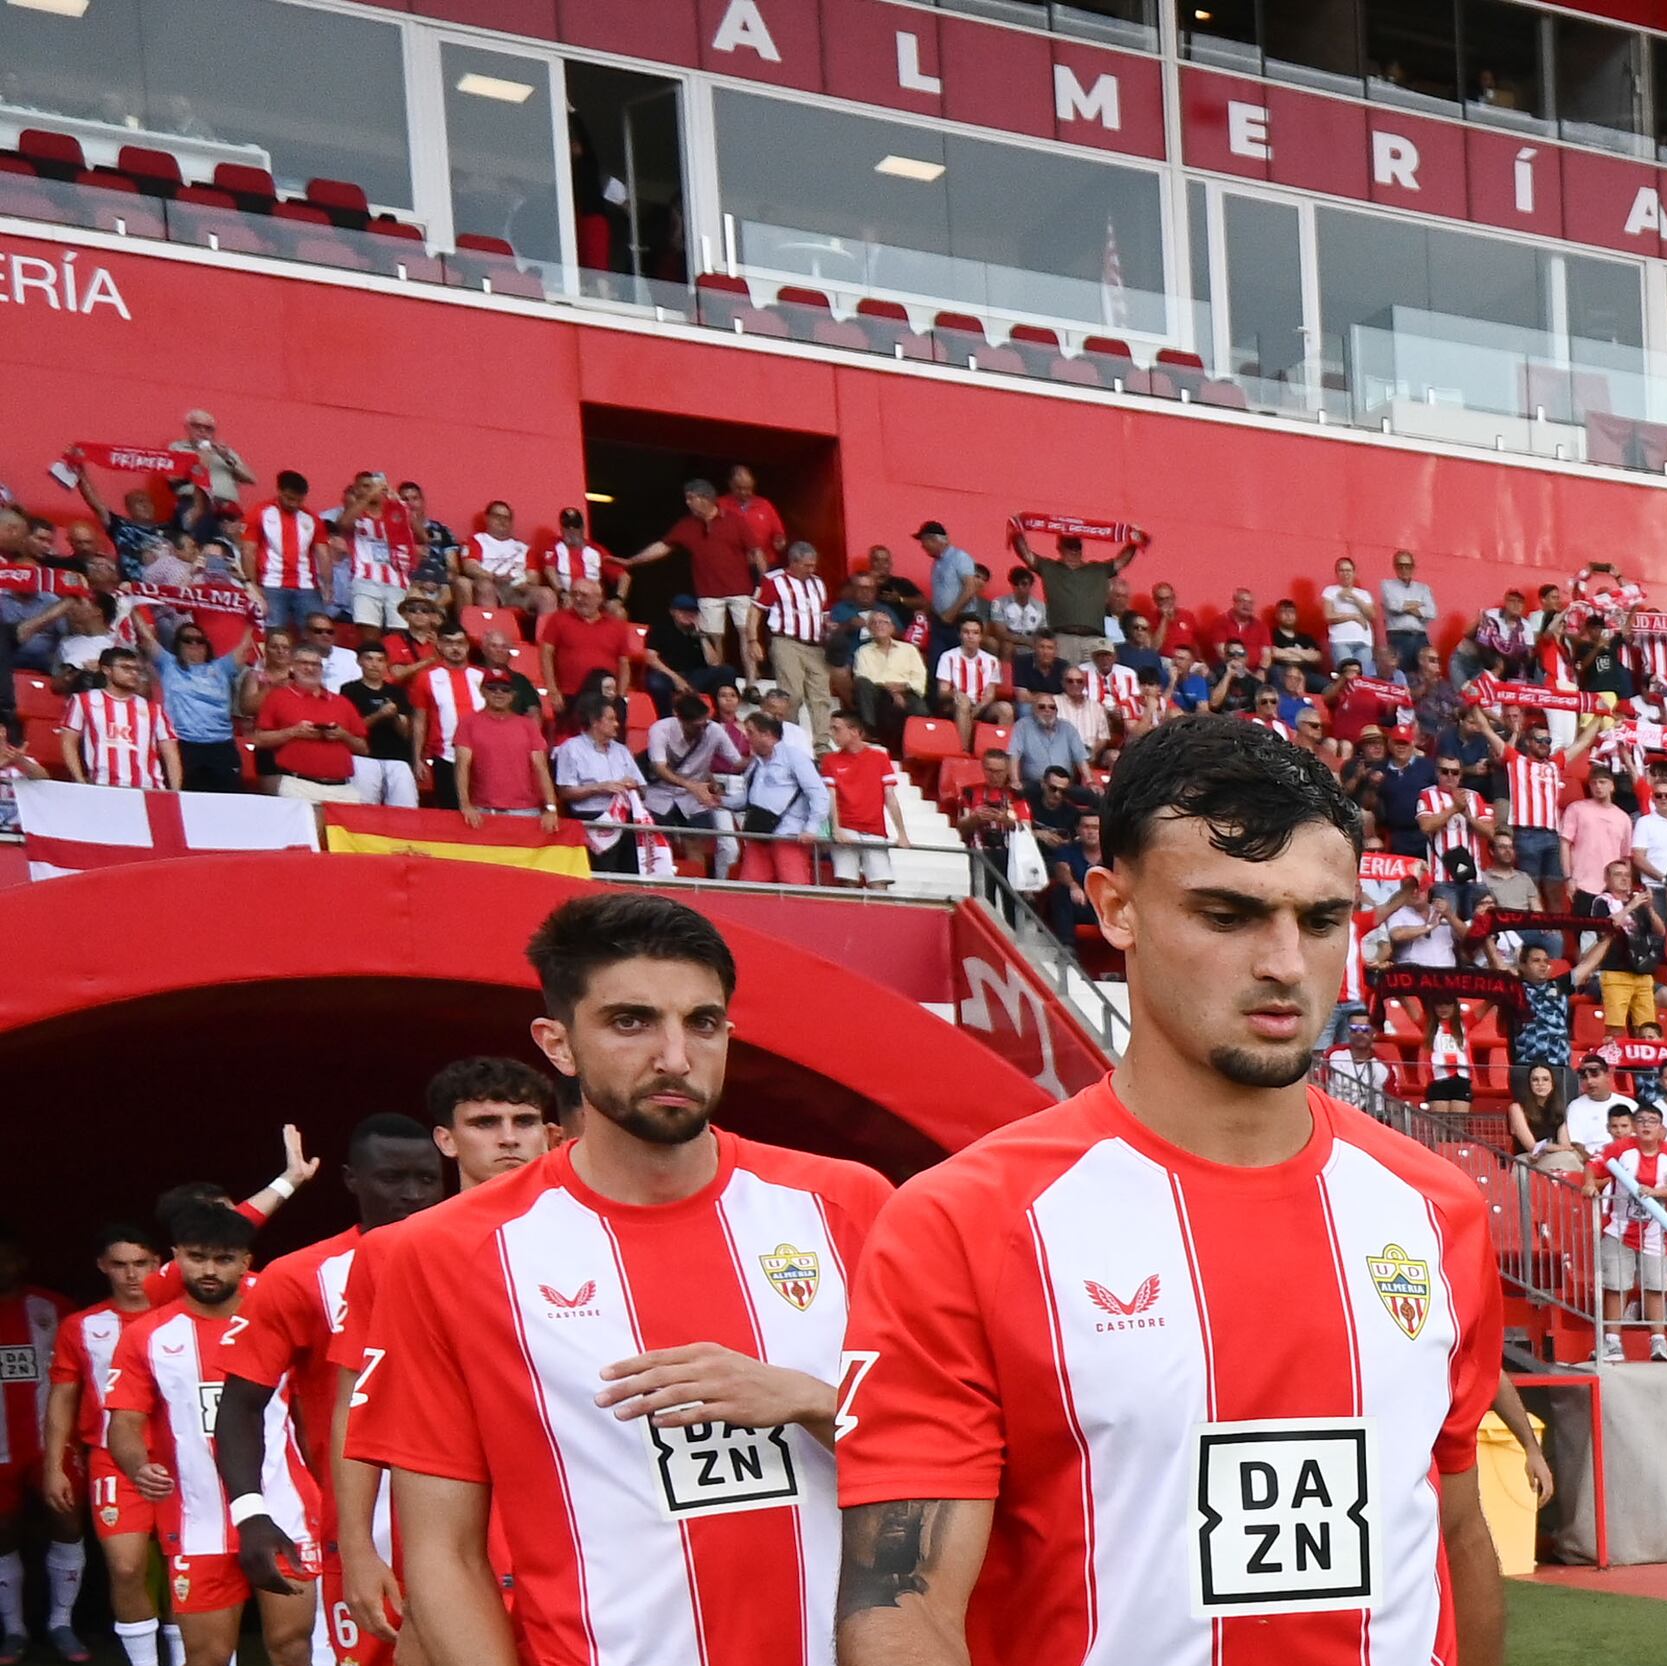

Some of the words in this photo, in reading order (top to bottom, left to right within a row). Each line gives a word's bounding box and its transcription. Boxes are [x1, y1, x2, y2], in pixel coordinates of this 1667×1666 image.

[0, 251, 132, 320] RÍA
[1360, 856, 1406, 876] ERIA
[1625, 1043, 1657, 1060] UD
[1375, 1263, 1388, 1276] U
[1408, 1266, 1421, 1278] D
[1380, 1281, 1426, 1296] ALMERIA
[1095, 1316, 1166, 1333] CASTORE
[690, 1445, 763, 1486] ZN
[1240, 1458, 1332, 1511] DA
[1244, 1521, 1332, 1575] ZN
